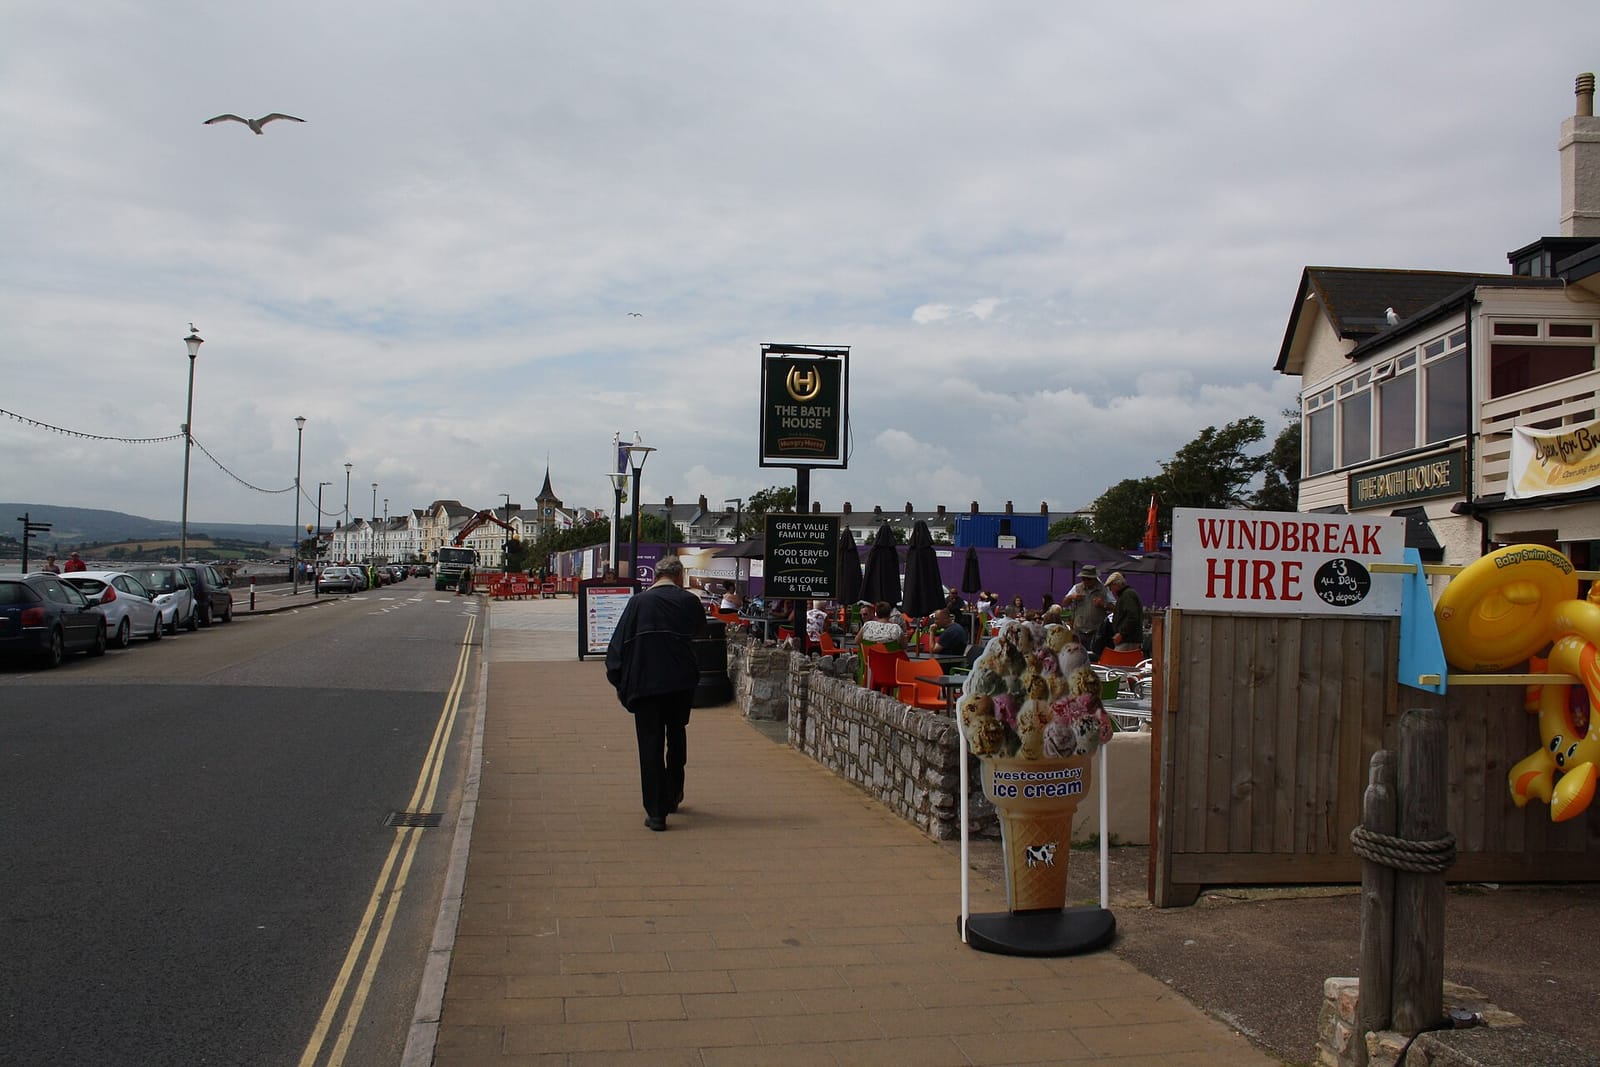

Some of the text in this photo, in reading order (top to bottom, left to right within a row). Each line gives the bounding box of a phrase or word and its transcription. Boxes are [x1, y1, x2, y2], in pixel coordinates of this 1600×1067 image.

[774, 405, 831, 417] THE BATH
[781, 418, 822, 429] HOUSE
[1556, 435, 1578, 463] for
[1356, 460, 1451, 502] THE BATH HOUSE
[775, 522, 829, 531] GREAT VALUE
[778, 531, 808, 539] FAMILY
[1198, 518, 1382, 555] WINDBREAK
[774, 548, 829, 557] FOOD SERVED
[1495, 552, 1521, 568] Baby
[1522, 549, 1545, 560] Swim
[784, 557, 818, 565] ALL DAY
[712, 569, 744, 577] connectd
[1332, 559, 1348, 576] £3
[773, 575, 829, 584] FRESH COFFEE
[1205, 558, 1303, 601] HIRE
[798, 584, 812, 592] TEA
[1335, 590, 1362, 605] deposit
[994, 768, 1083, 781] westcountry
[993, 780, 1083, 798] ice cream
